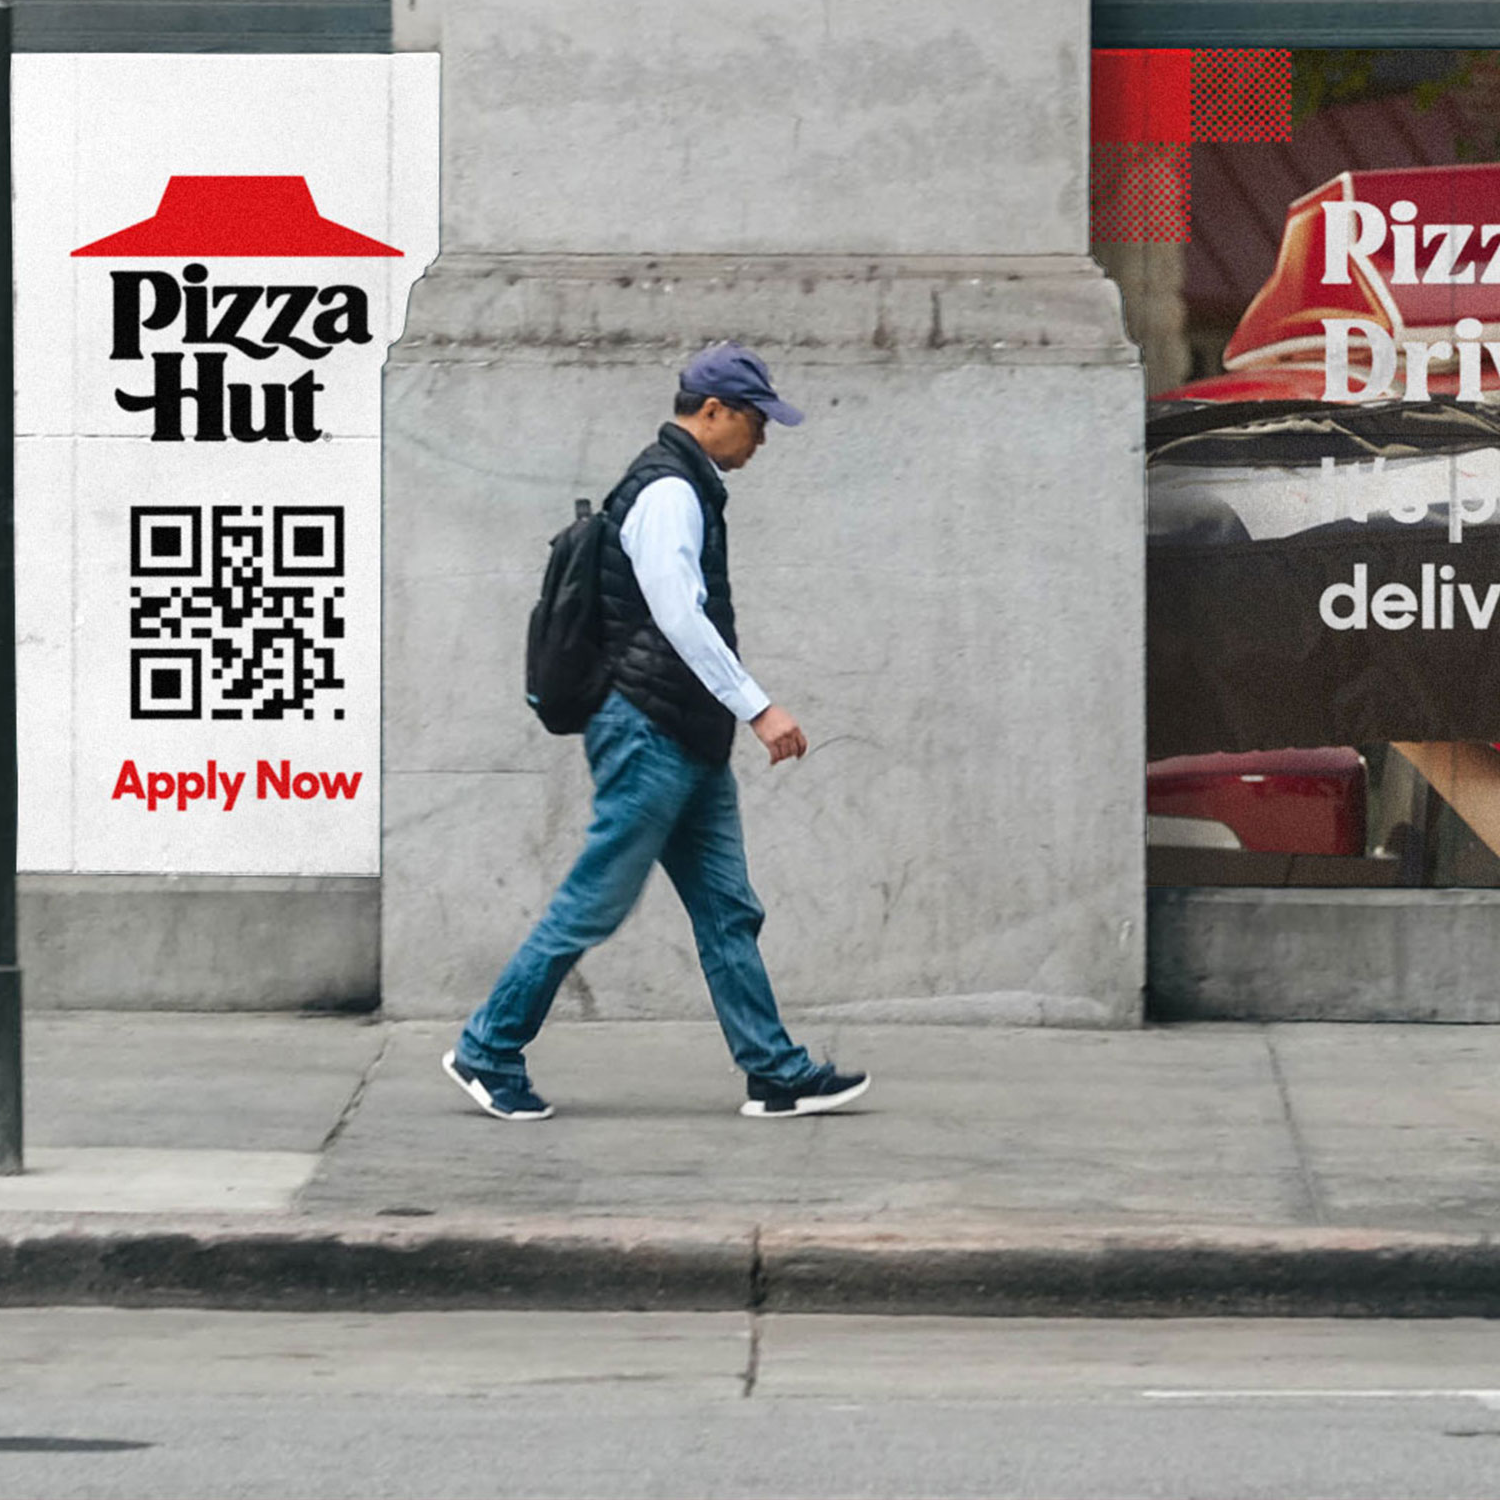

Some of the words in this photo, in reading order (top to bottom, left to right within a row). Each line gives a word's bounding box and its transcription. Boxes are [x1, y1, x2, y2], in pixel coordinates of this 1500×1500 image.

[109, 263, 374, 361] Pizza
[114, 351, 325, 443] Hut
[112, 759, 246, 812] Apply
[256, 759, 363, 800] Now
